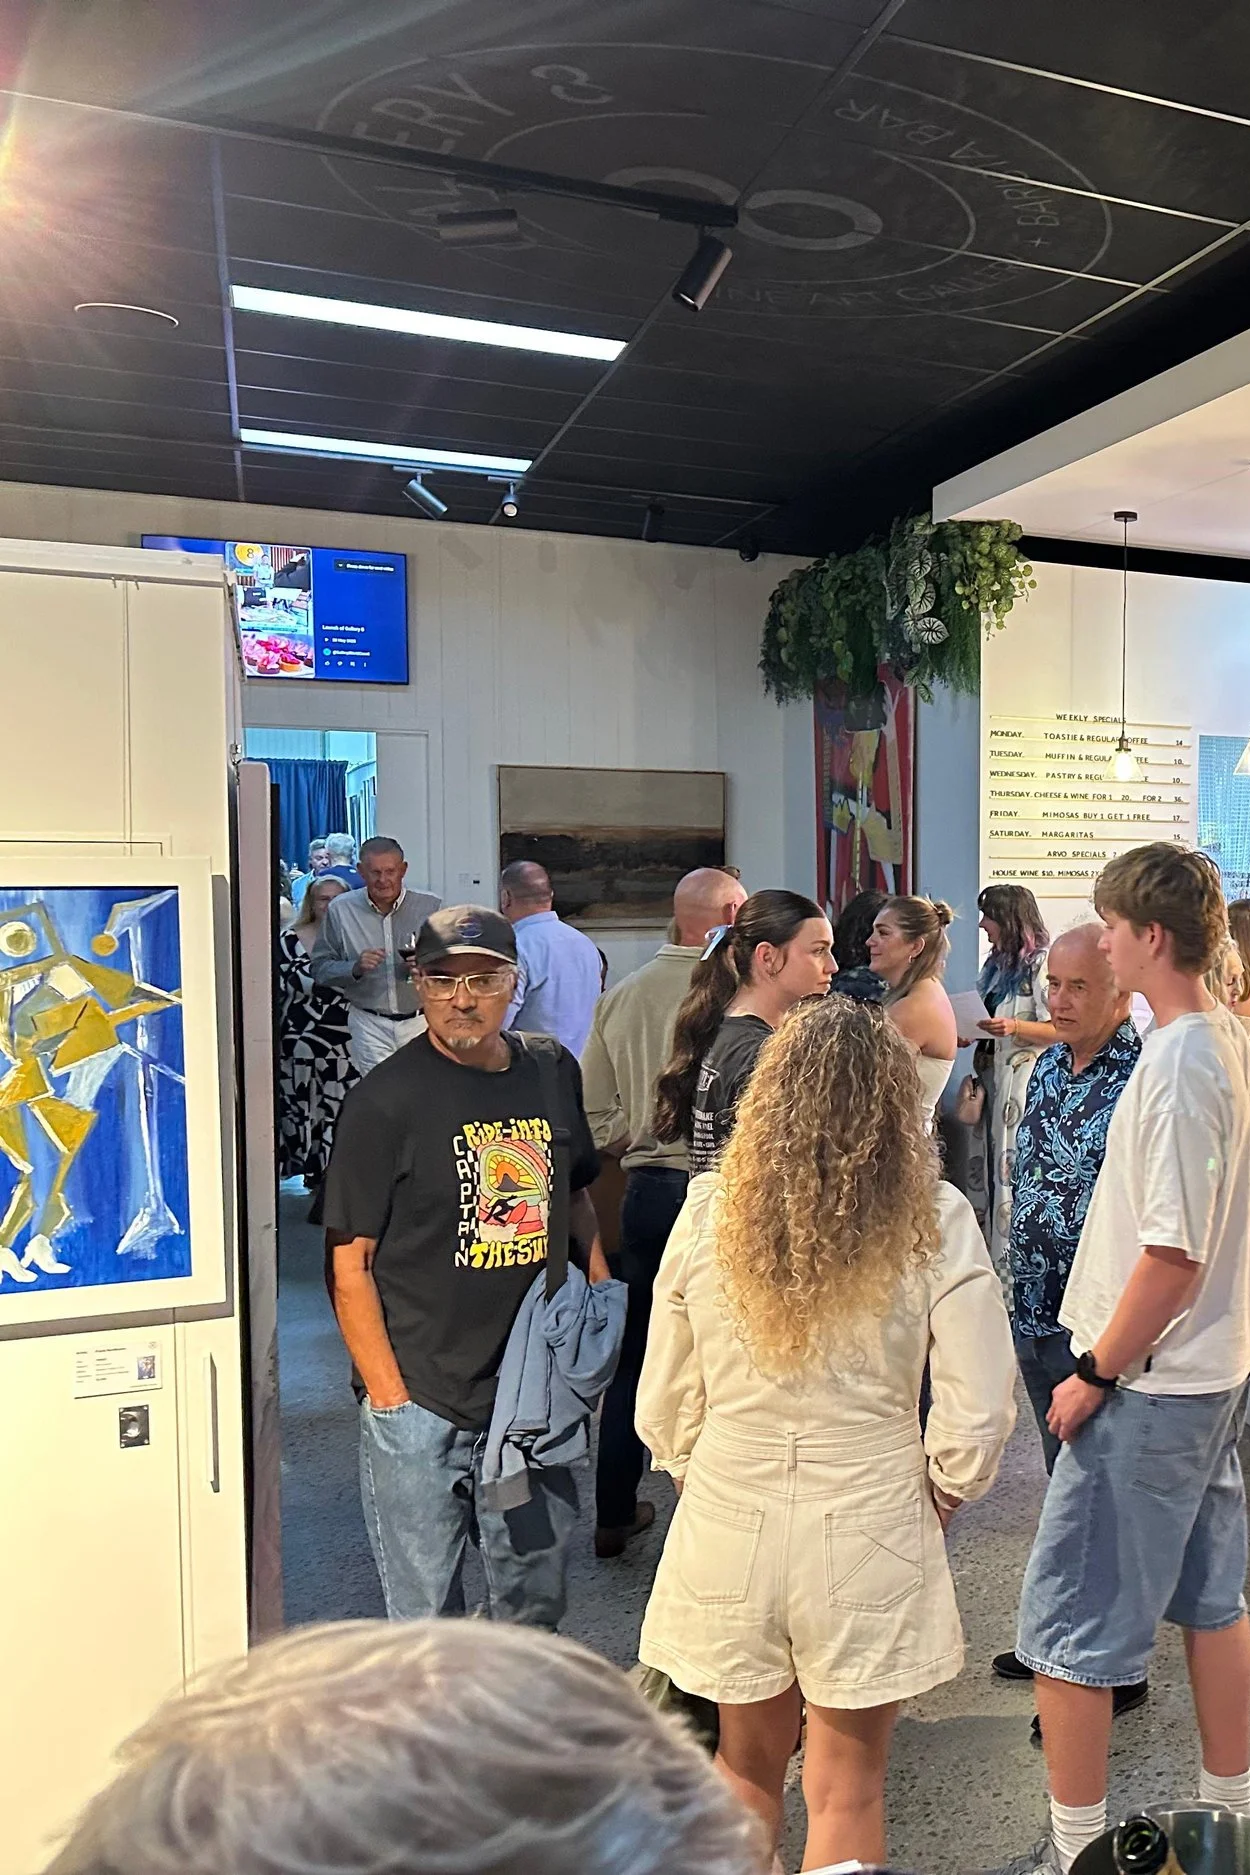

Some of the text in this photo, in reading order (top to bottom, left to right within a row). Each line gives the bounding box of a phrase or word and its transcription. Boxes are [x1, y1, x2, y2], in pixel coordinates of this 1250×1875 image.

[714, 284, 776, 304] INE
[1055, 713, 1127, 724] WEEKLY SPECIALS
[990, 730, 1025, 738] MONDAY.
[1044, 732, 1078, 741] TOASTIE
[1127, 737, 1149, 745] OFFEE
[989, 750, 1025, 758] TUESDAY.
[1085, 754, 1112, 762] REGULA
[989, 770, 1038, 778] WEDNESDAY.
[1045, 772, 1076, 780] PASTRY
[990, 790, 1033, 798] THURSDAY.
[1034, 791, 1061, 799] CHEESE
[1092, 793, 1107, 801] FOR
[1042, 811, 1079, 819] MIMOSAS
[989, 830, 1032, 838] SATURDAY.
[1042, 831, 1094, 839] MARGARITAS
[992, 869, 1018, 877] HOUSE
[453, 1135, 473, 1268] CAPTAIN
